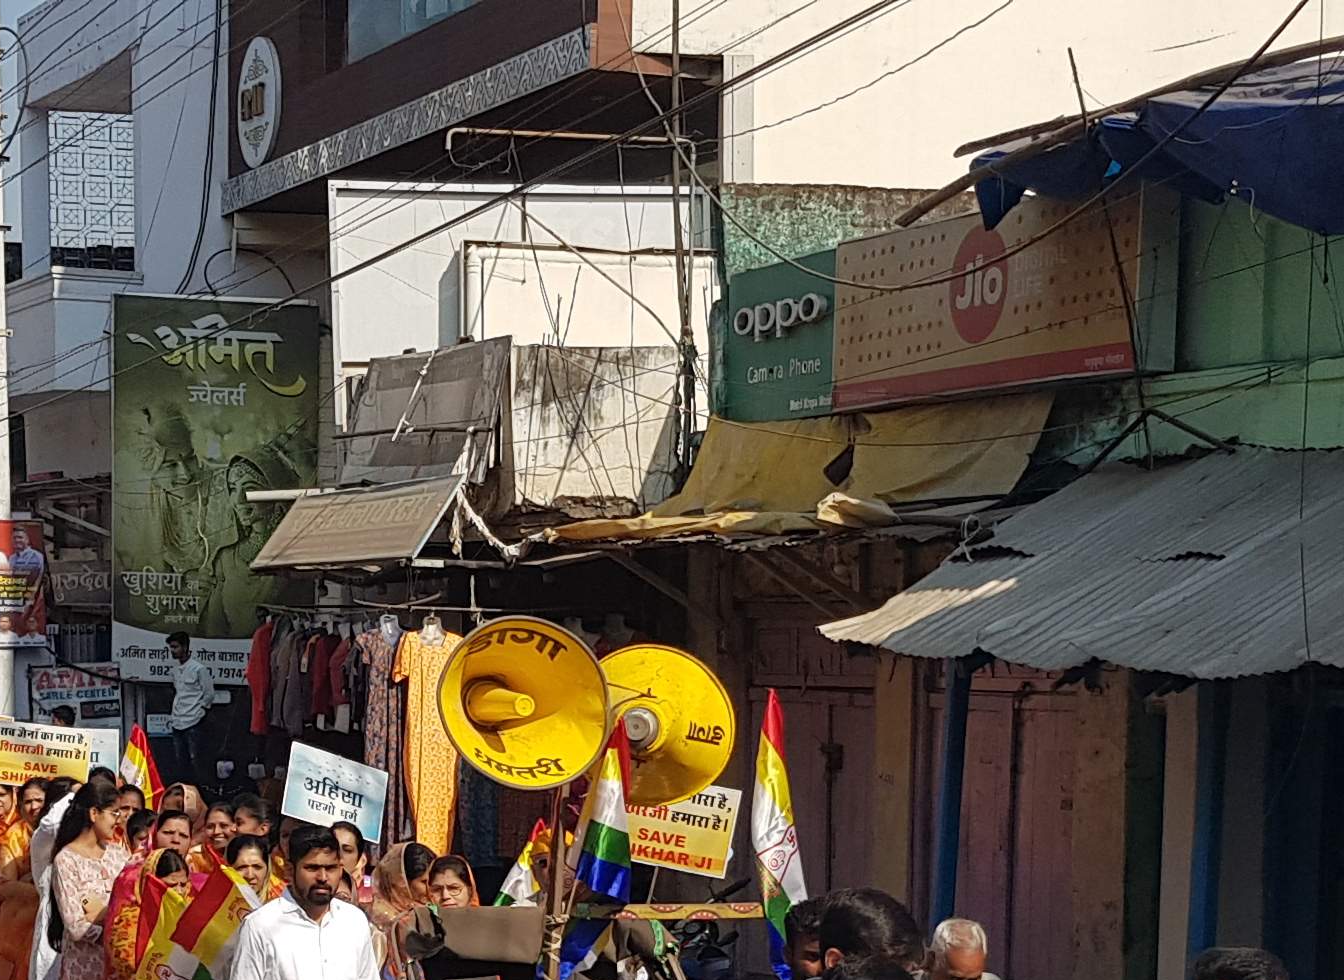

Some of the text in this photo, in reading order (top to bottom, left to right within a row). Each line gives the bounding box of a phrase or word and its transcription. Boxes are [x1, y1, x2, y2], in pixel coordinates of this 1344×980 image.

[956, 254, 1003, 310] Jio
[126, 313, 306, 398] अमित
[788, 357, 821, 377] Phone
[186, 382, 247, 406] ज्वेलर्स
[120, 566, 183, 596] खुशियों
[119, 645, 146, 660] अमित
[217, 650, 244, 662] बाजार
[465, 626, 569, 662] डागा
[40, 731, 53, 741] का
[23, 761, 58, 774] SAVE
[473, 747, 568, 780] धमतरी
[303, 777, 364, 809] अहिंसा
[670, 808, 709, 831] हमारा
[637, 827, 686, 848] SAVE
[693, 852, 713, 870] JI
